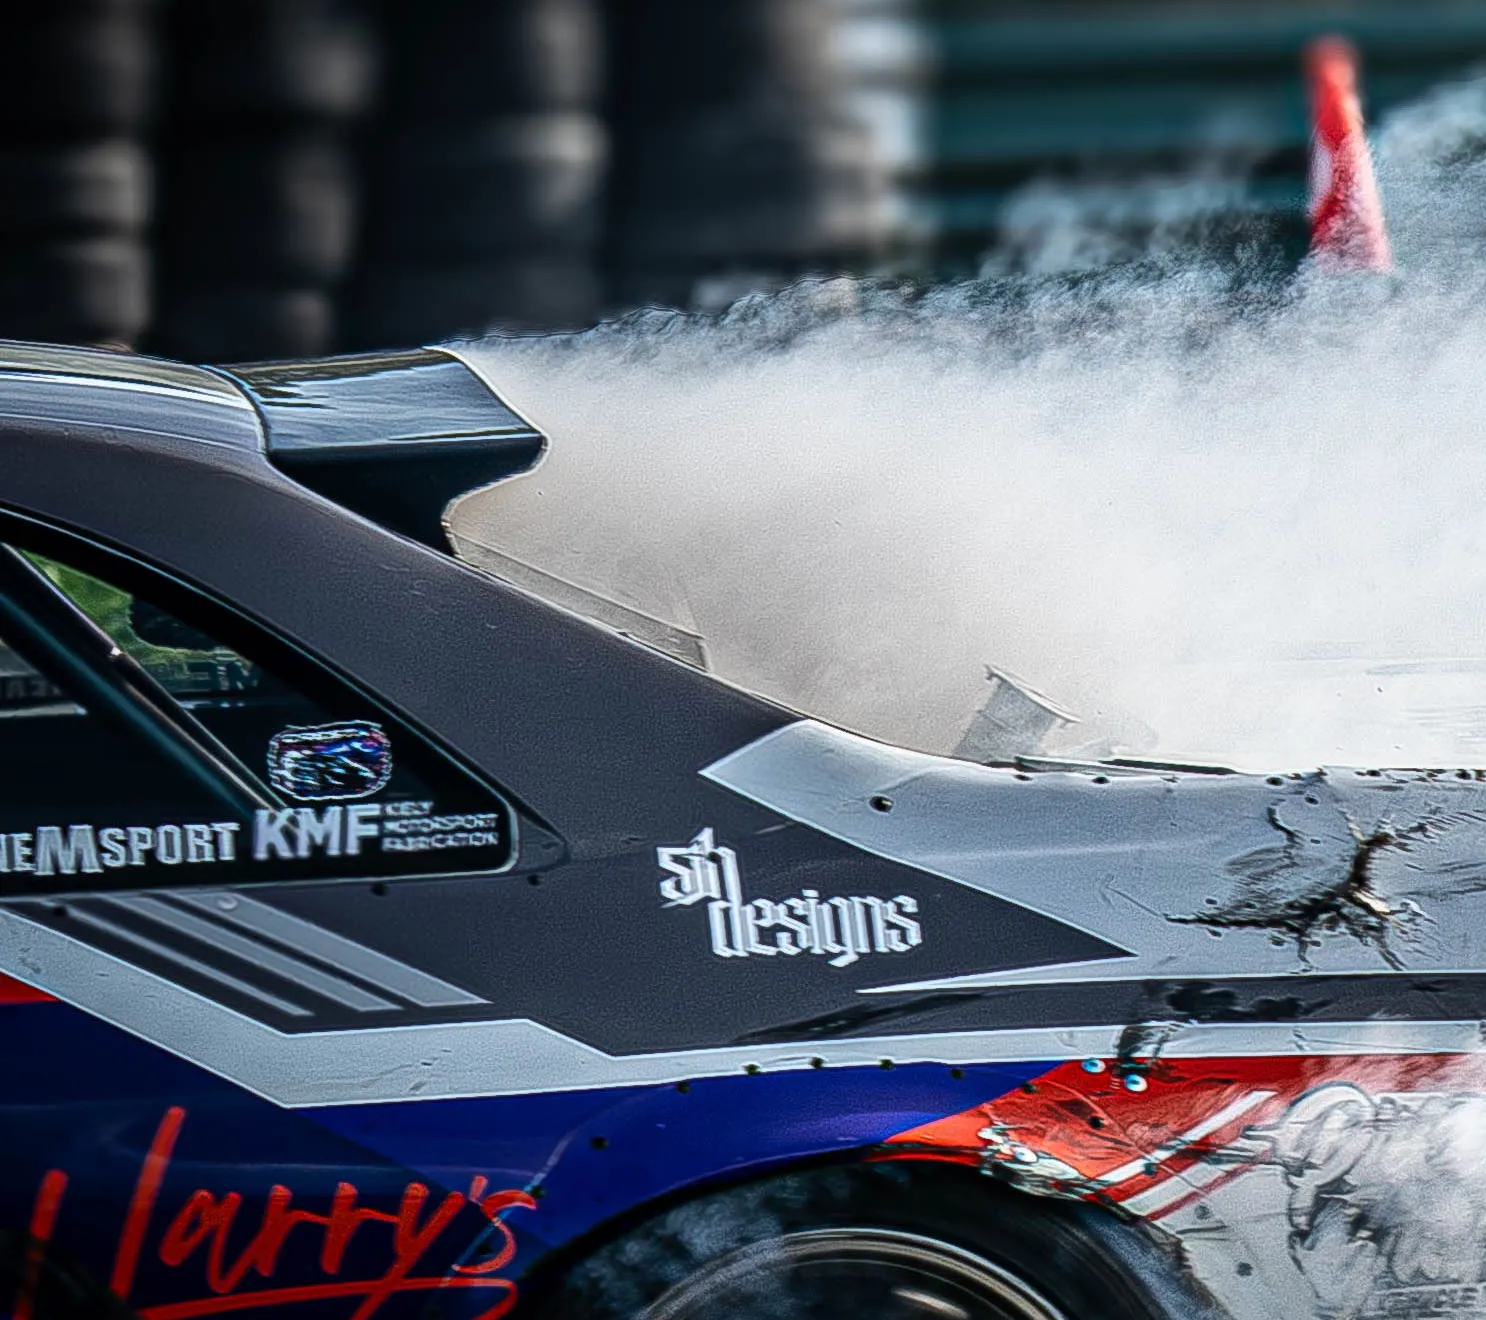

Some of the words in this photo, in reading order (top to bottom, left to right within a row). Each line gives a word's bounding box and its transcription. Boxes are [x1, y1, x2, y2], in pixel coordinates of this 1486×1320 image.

[0, 822, 240, 876] EMSPORT
[254, 803, 382, 860] KMF
[707, 845, 922, 968] designs
